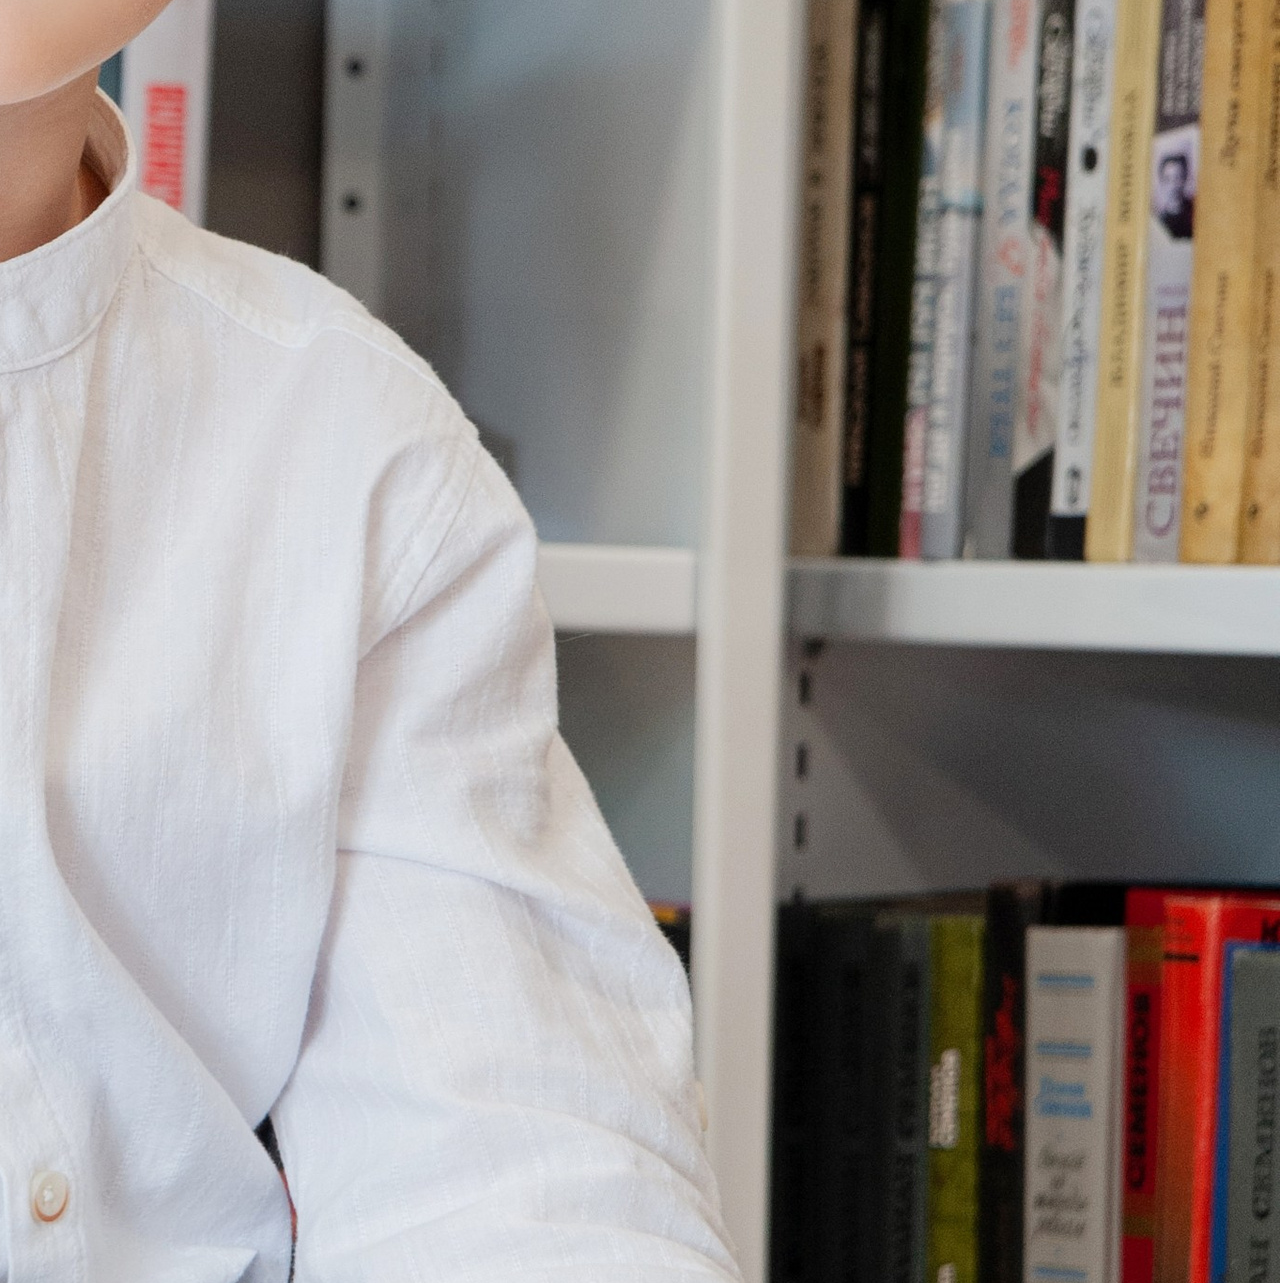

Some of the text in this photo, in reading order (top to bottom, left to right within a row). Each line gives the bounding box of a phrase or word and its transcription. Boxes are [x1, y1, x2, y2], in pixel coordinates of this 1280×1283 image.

[1145, 300, 1189, 538] СВЕЧИН
[1127, 992, 1152, 1190] СЕМЕНОВ
[1251, 1026, 1279, 1221] СЕМЕНОВ
